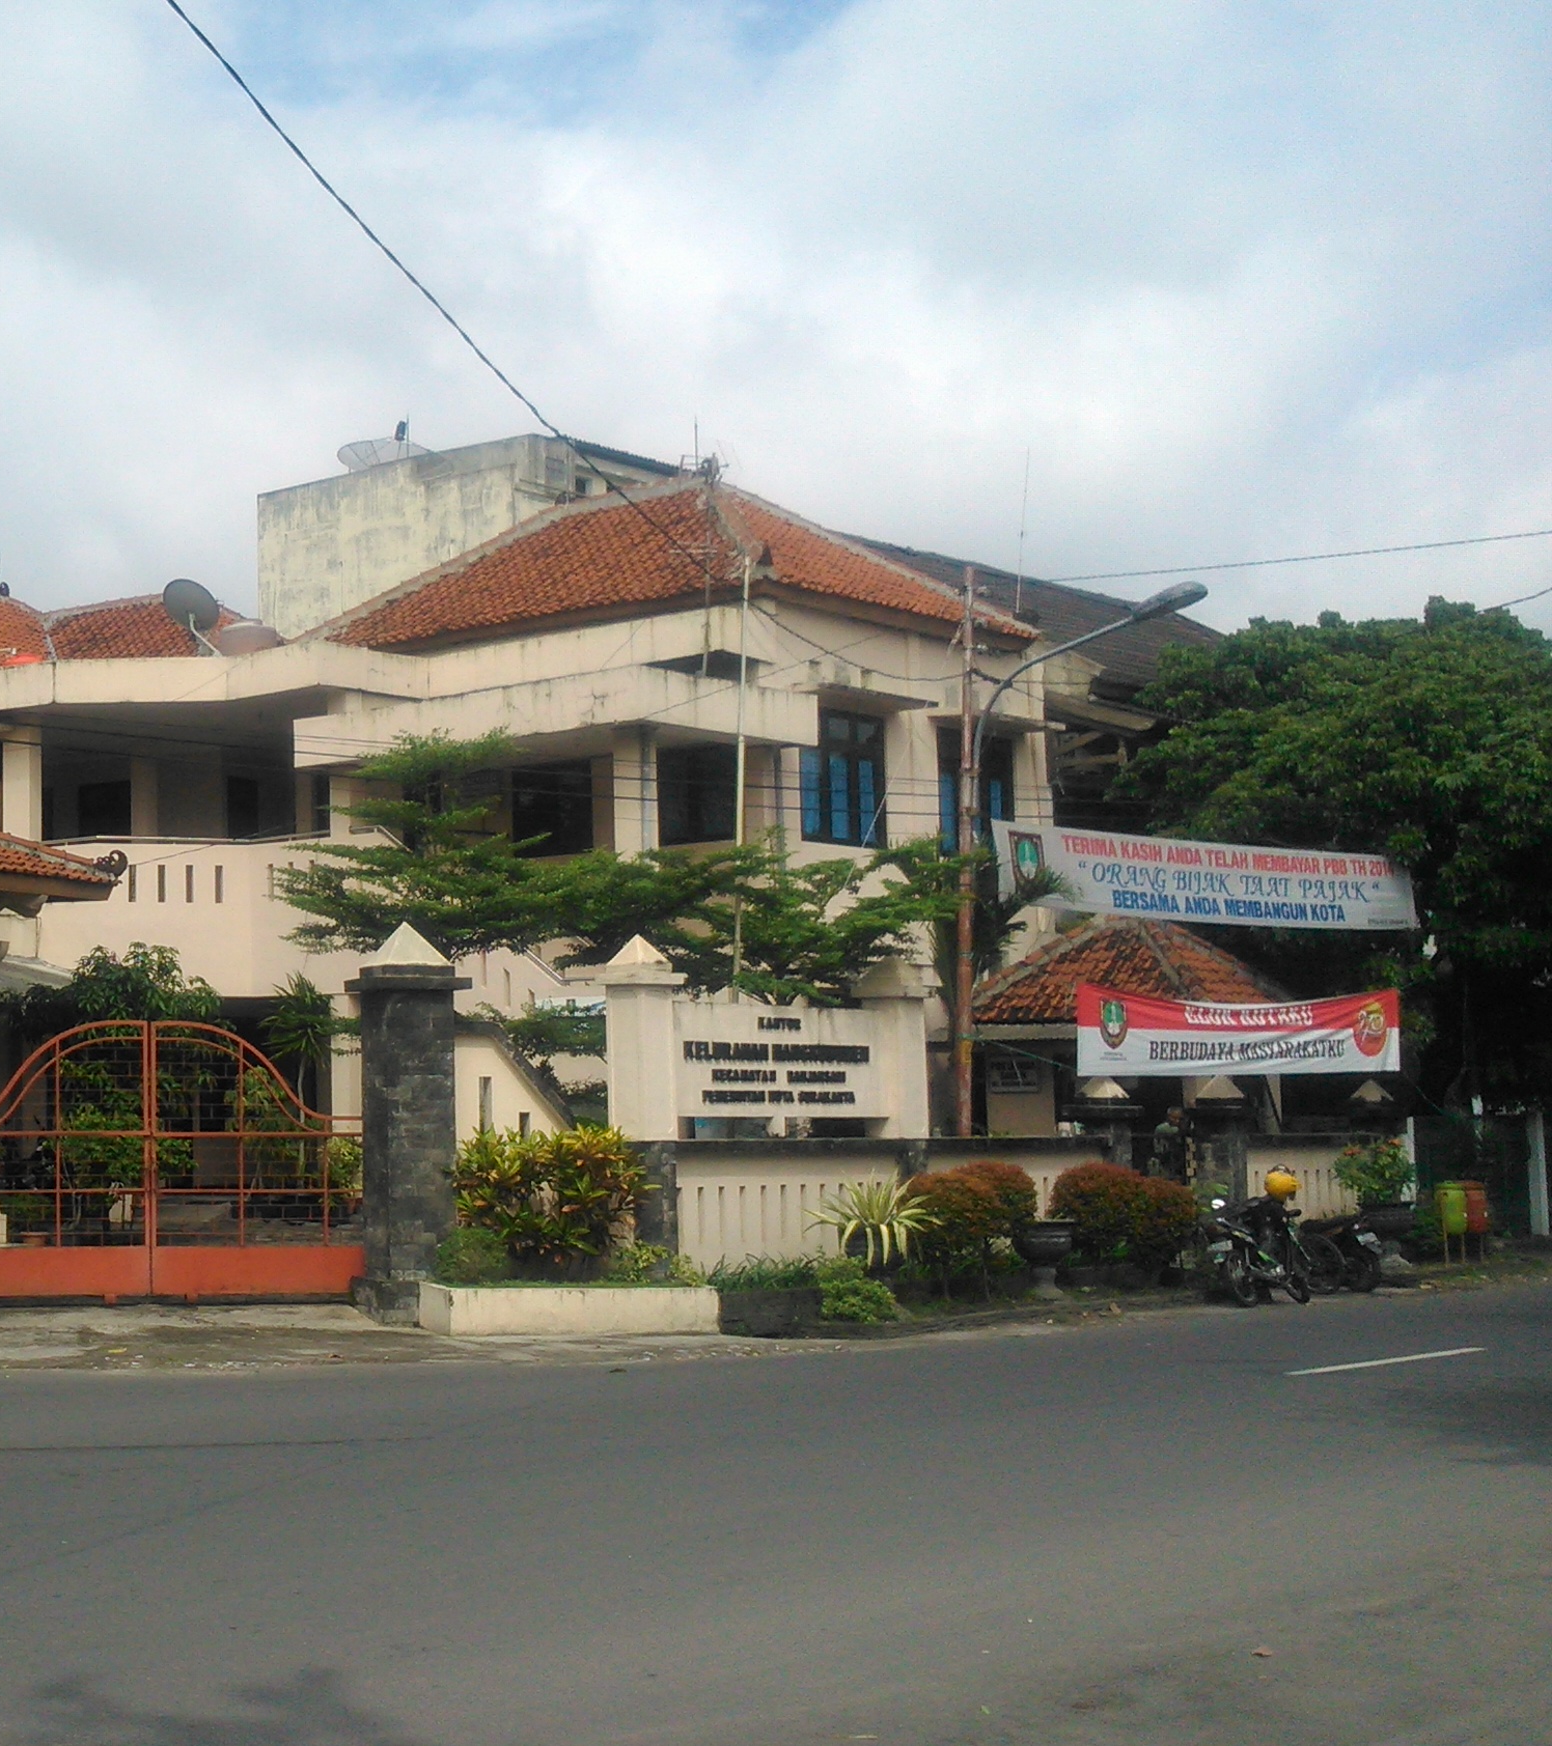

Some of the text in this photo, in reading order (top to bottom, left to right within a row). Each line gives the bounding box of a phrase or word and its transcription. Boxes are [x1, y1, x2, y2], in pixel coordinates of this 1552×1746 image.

[1061, 834, 1117, 858] TERIMA
[1121, 841, 1163, 862] KASIH
[1167, 846, 1202, 866] ANDA
[1205, 849, 1248, 870] TELAH
[1252, 853, 1320, 874] MEMBAYAR
[1350, 859, 1367, 877] TH
[1092, 862, 1167, 894] ORANG
[1172, 869, 1235, 896] BIJAK
[1240, 874, 1292, 898] TAAT
[1299, 878, 1369, 902] PAJAK
[1112, 889, 1346, 922] BERSAMA ANDA MEMBANGUN KOTA
[1149, 1040, 1235, 1060] BERBUDAYA
[1237, 1039, 1346, 1060] MASYARAKATKU
